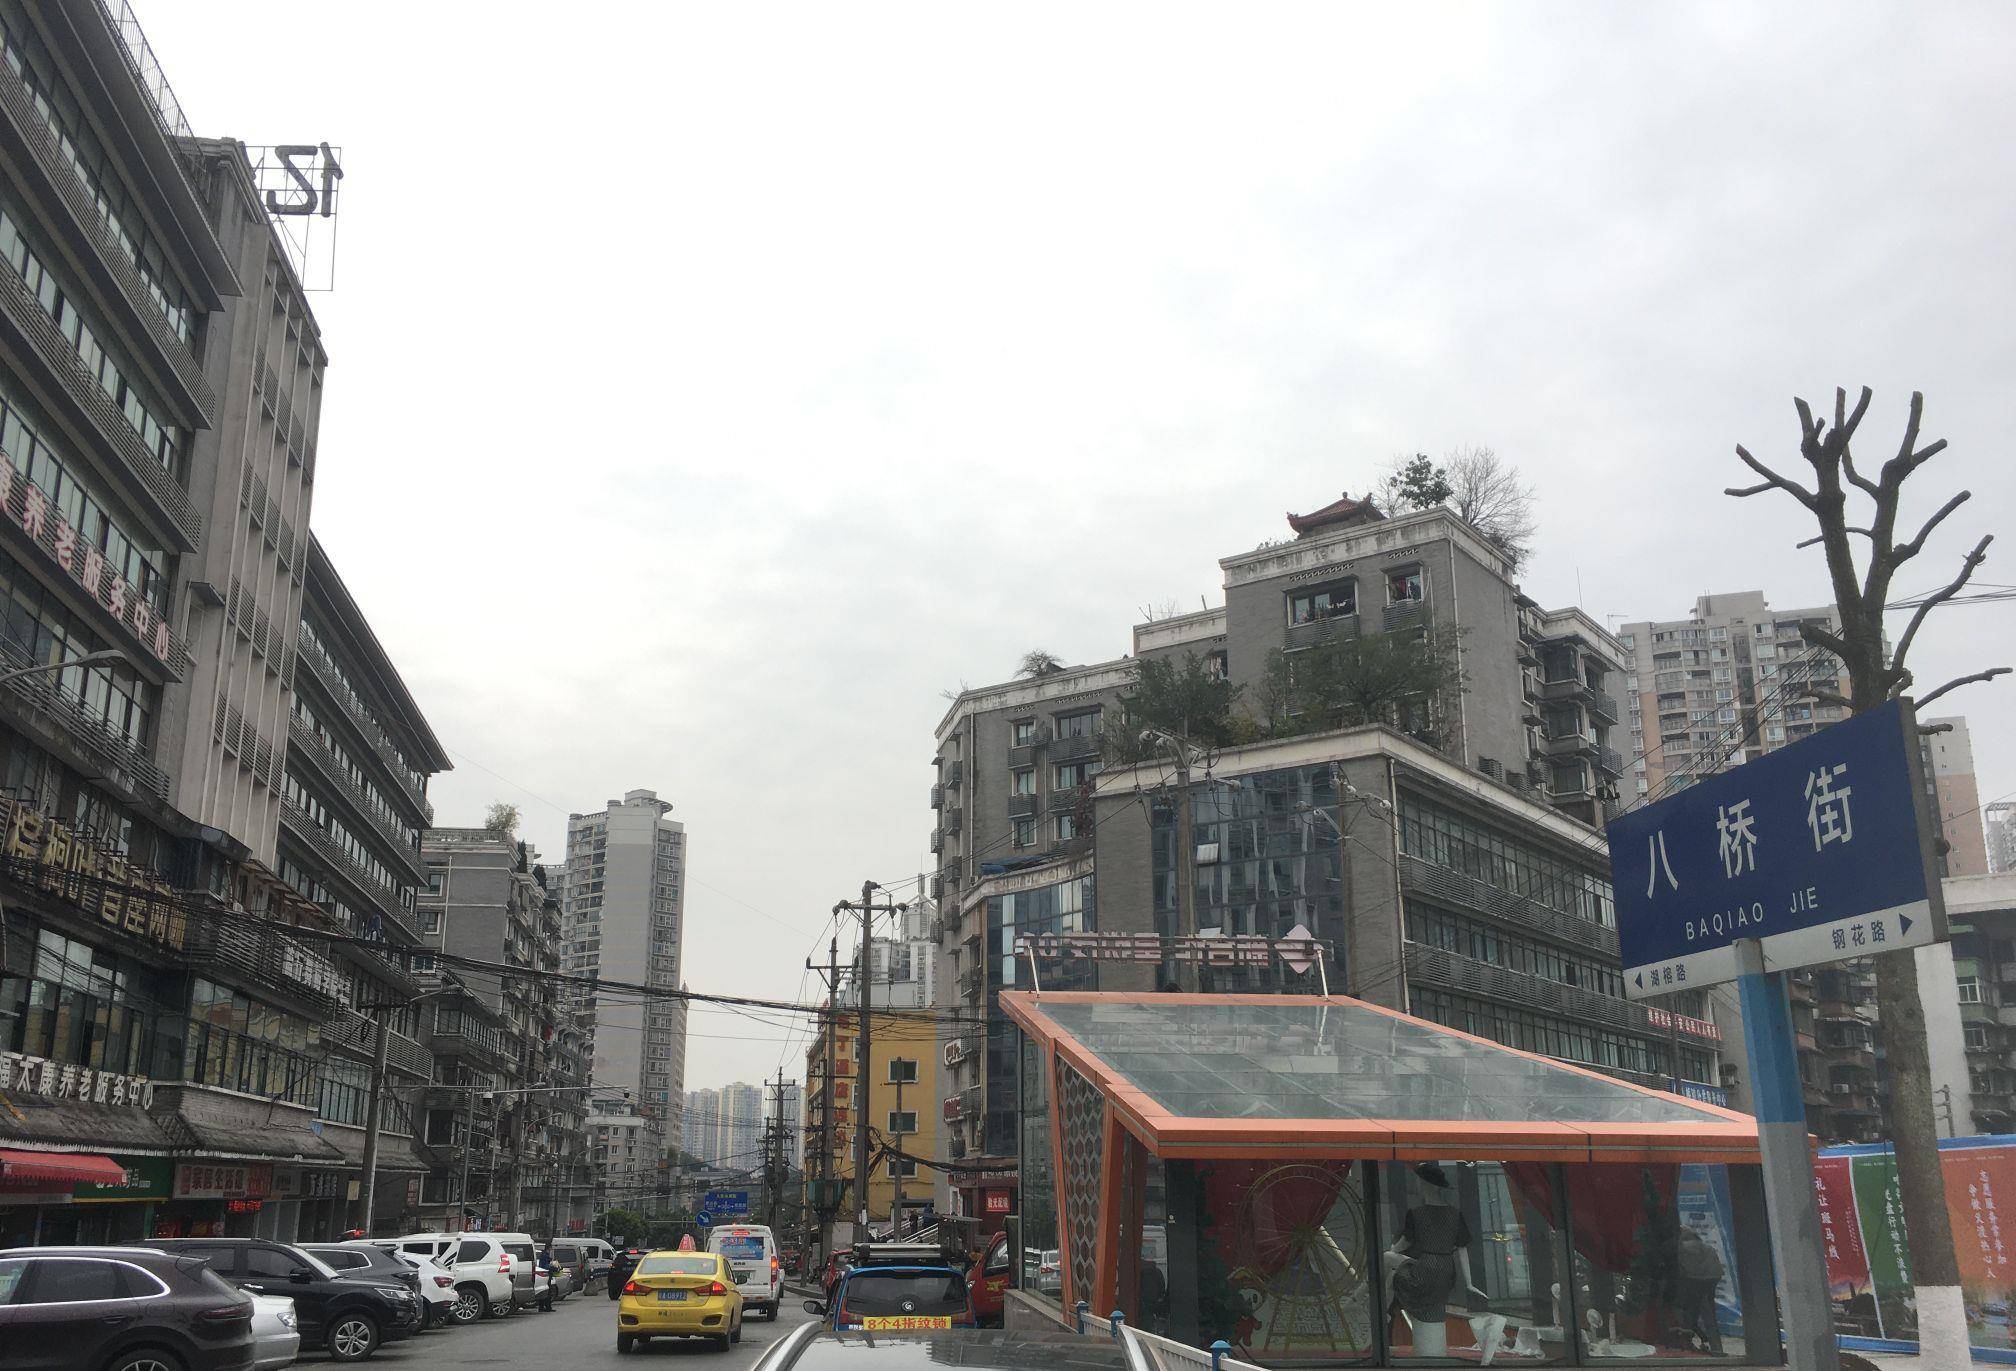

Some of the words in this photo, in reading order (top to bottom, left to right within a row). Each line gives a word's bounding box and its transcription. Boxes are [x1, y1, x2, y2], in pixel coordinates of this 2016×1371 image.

[1646, 762, 1854, 899] 八桥街
[1686, 902, 1764, 941] BAQIAO
[1789, 886, 1819, 914] JIE
[1831, 919, 1886, 951] 钢花路
